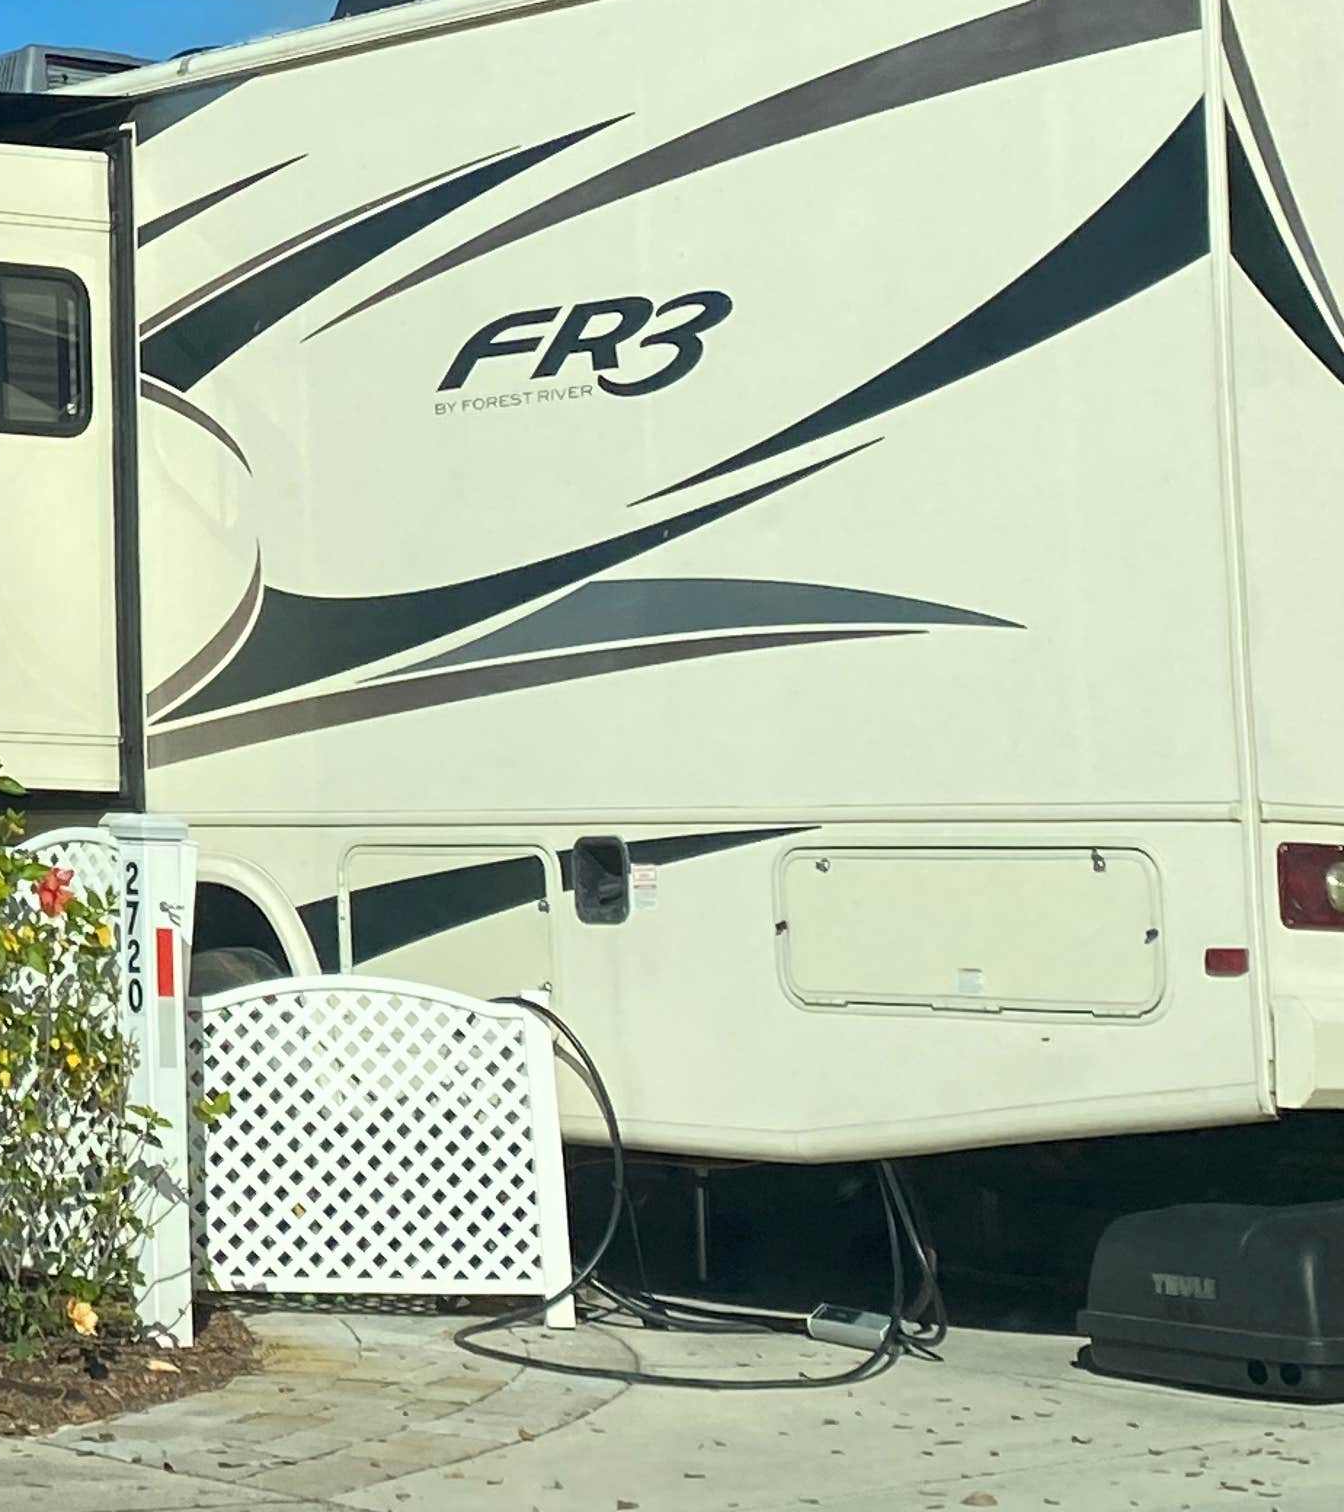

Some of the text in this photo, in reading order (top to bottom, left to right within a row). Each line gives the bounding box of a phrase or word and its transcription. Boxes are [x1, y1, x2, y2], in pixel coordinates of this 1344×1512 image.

[437, 290, 733, 397] FR3
[434, 384, 593, 416] BY FOREST RIVER
[126, 862, 144, 1013] 2720
